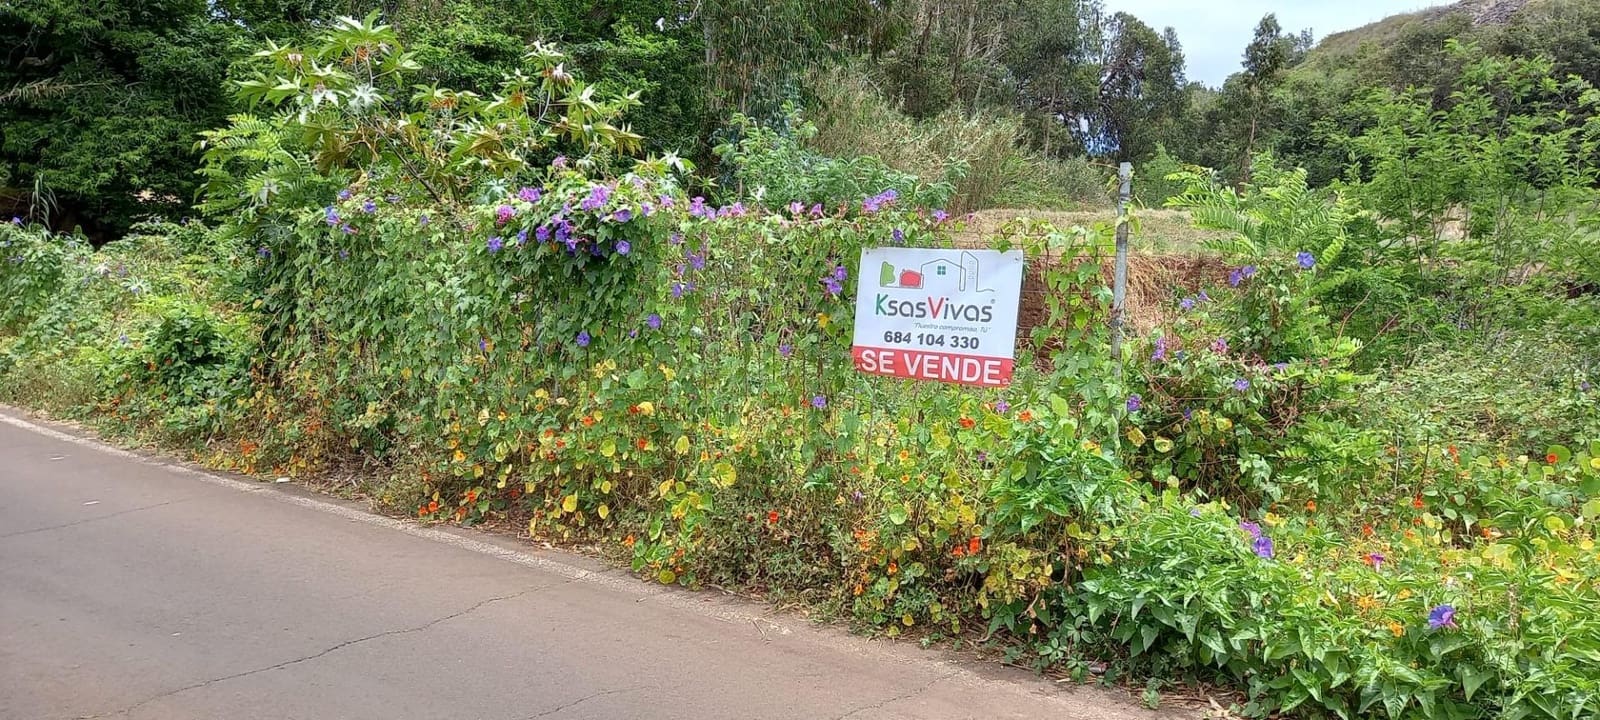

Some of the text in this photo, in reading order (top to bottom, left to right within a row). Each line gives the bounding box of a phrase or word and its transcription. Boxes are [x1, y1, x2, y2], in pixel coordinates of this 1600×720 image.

[884, 330, 979, 350] 684 104 330
[861, 350, 1001, 385] SE VENDE
